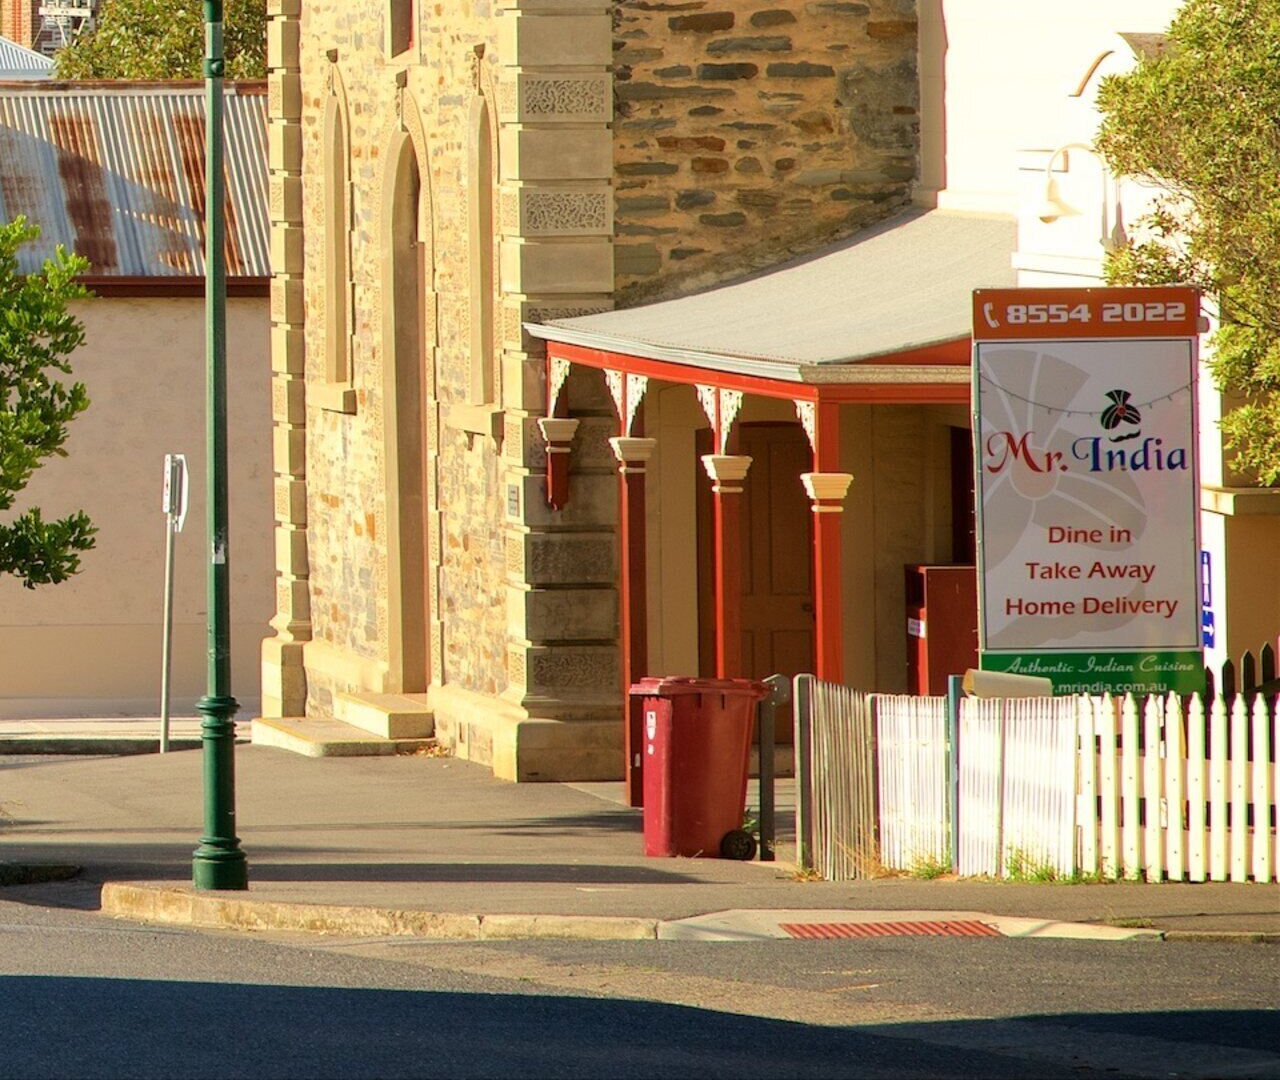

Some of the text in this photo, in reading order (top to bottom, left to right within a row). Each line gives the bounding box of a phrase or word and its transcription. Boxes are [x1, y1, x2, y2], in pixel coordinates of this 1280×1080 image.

[1006, 302, 1186, 324] 8554 2022
[987, 431, 1188, 473] Mr. India
[1048, 526, 1131, 543] Dine in
[1025, 561, 1156, 583] Take Away
[1005, 597, 1179, 618] Home Delivery
[1004, 655, 1194, 673] Authentic Indian Cuisine
[1052, 682, 1167, 693] .mrindia.com.au
